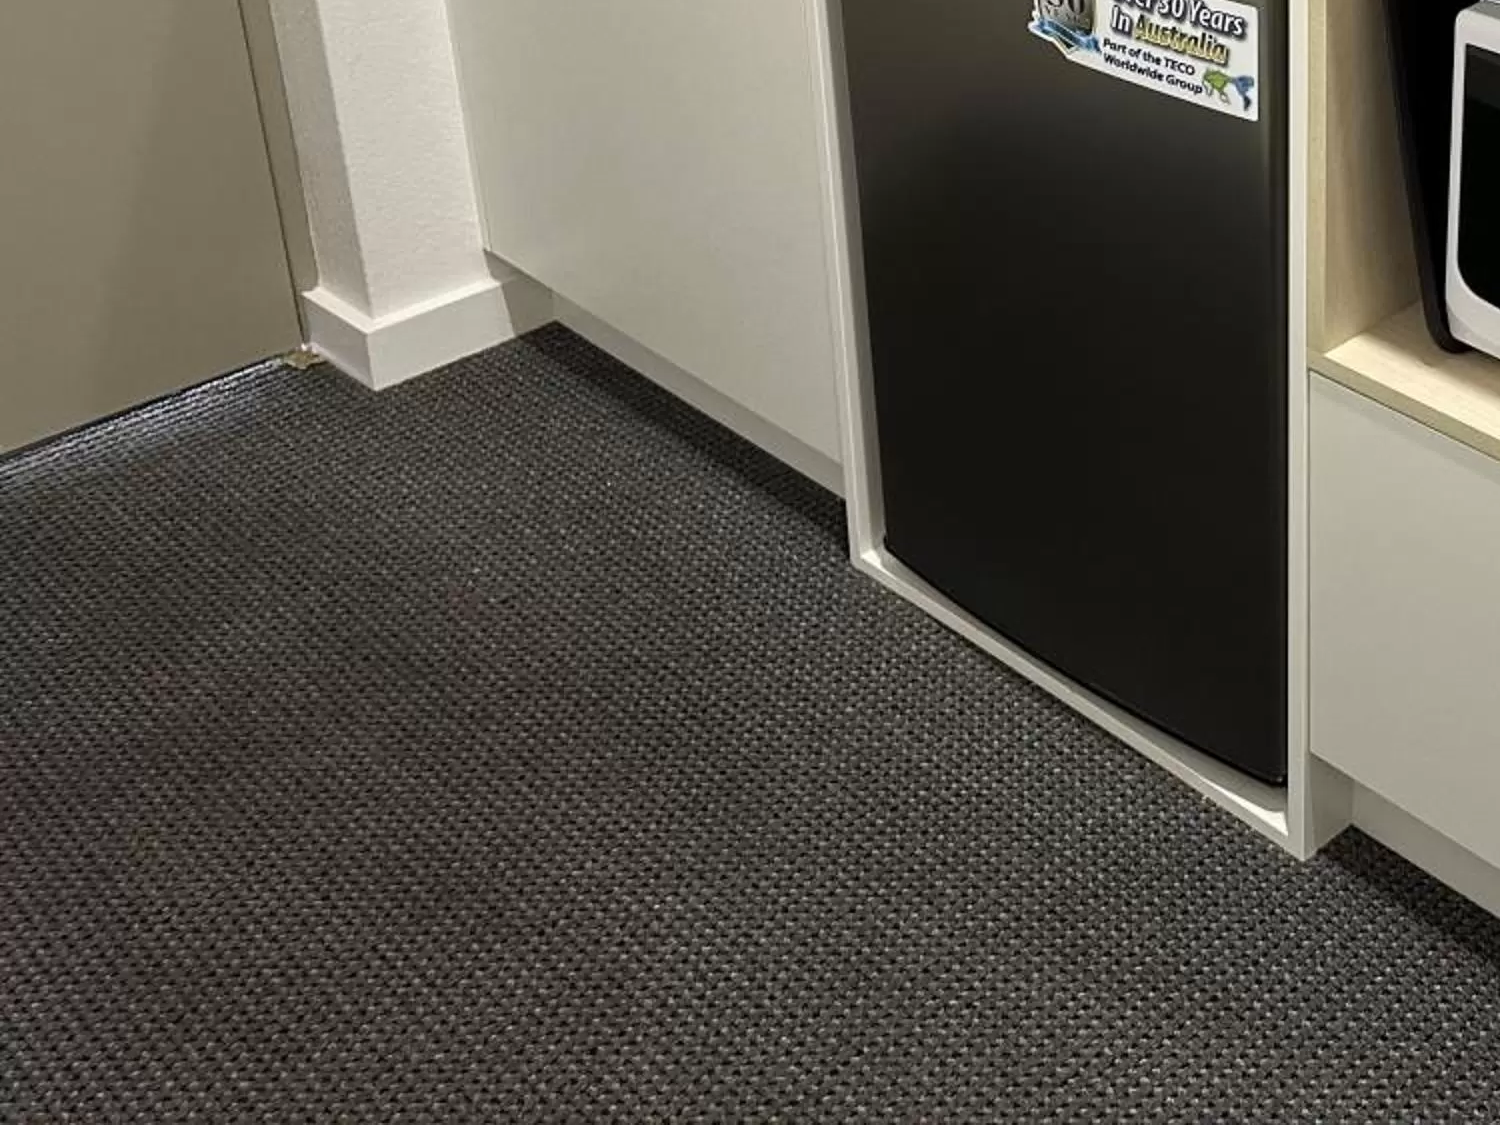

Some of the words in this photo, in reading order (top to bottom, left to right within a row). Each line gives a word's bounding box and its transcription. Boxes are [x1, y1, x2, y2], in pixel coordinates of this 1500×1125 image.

[1111, 4, 1133, 35] In
[1135, 14, 1229, 66] Australia
[1103, 38, 1127, 54] Part
[1128, 48, 1142, 60] of
[1143, 51, 1162, 66] the
[1164, 56, 1196, 76] TECO
[1103, 53, 1165, 82] Worldwide
[1166, 74, 1203, 95] Group
